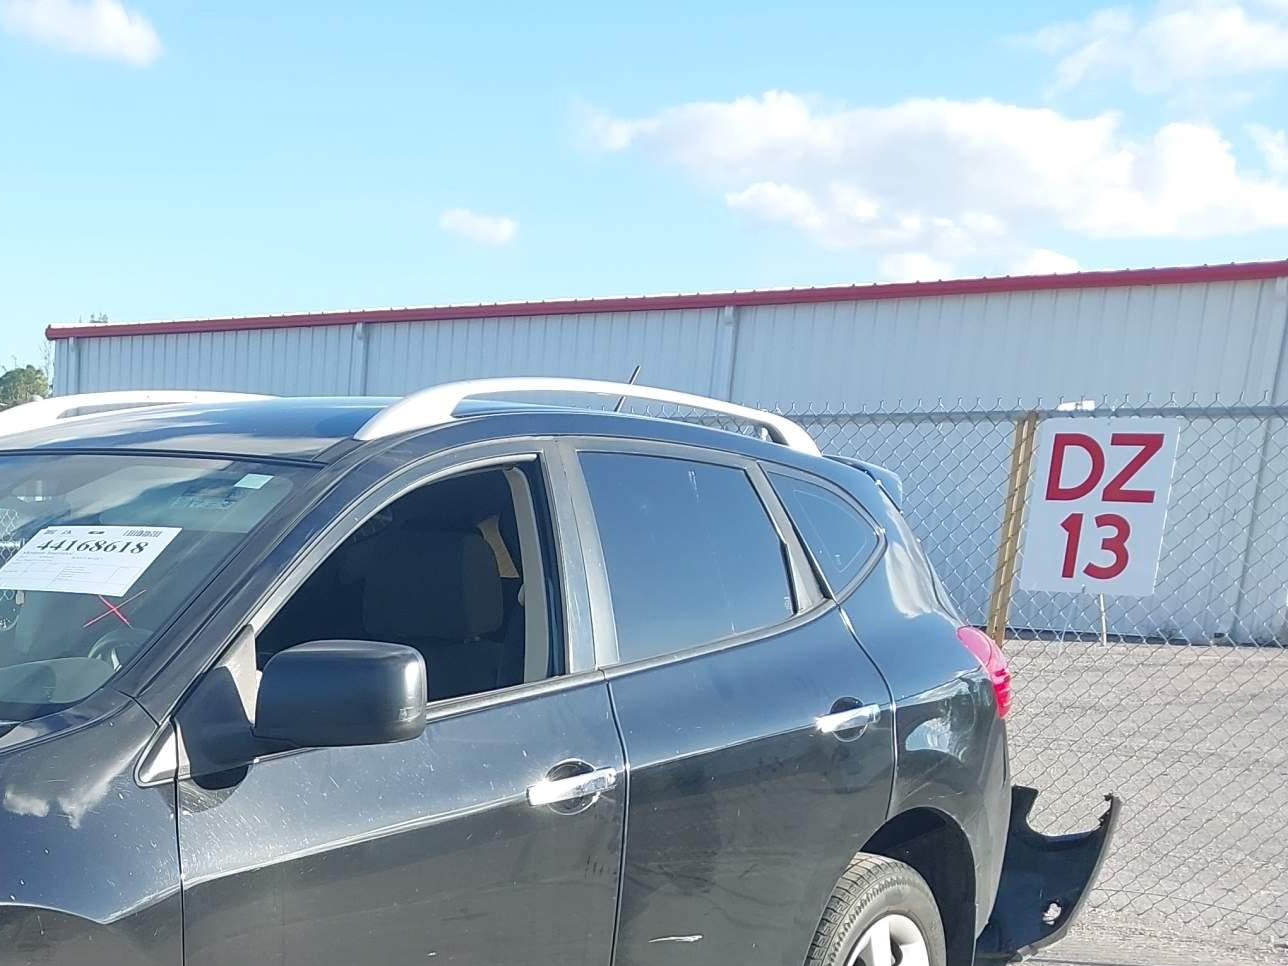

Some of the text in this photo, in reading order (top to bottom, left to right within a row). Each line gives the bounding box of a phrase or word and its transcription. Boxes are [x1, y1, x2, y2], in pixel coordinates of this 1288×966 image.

[1045, 433, 1165, 504] DZ
[37, 539, 149, 554] 44168618
[1059, 512, 1131, 579] 13
